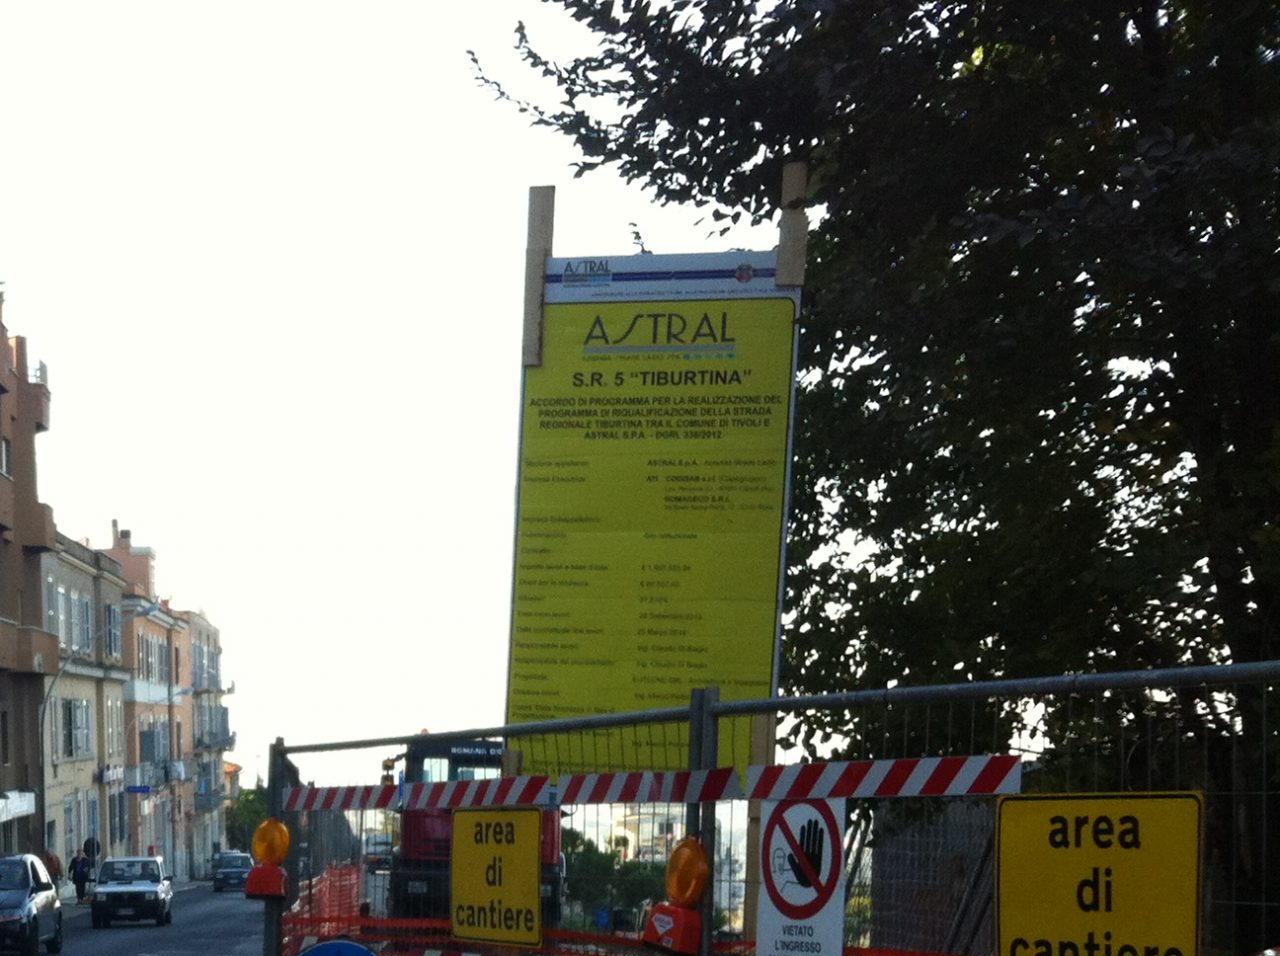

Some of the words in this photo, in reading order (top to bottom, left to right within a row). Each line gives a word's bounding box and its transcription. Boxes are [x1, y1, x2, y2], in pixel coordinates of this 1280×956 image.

[564, 259, 611, 273] ASTRAL
[583, 311, 736, 345] ASTRAL
[572, 372, 607, 388] S.R.
[614, 371, 625, 387] 5
[530, 398, 576, 408] ACCORDO
[578, 397, 587, 407] DI
[589, 396, 650, 406] PROGRAMMA
[652, 396, 672, 405] PER
[674, 395, 685, 405] LA
[687, 394, 762, 405] REALIZZAZIONE
[764, 394, 781, 404] DEL
[538, 409, 598, 418] PROGRAMMA
[600, 408, 610, 417] DI
[612, 407, 697, 417] RIQUALIFICAZIONE
[700, 407, 731, 417] DELLA
[733, 406, 772, 416] STRADA
[540, 420, 592, 430] REGIONALE
[595, 419, 643, 429] TIBURTINA
[646, 419, 664, 429] TRA
[666, 419, 674, 428] IL
[676, 418, 717, 428] COMUNE
[719, 418, 729, 428] DI
[731, 417, 761, 427] TIVOLI
[763, 417, 770, 427] E
[584, 430, 619, 440] ASTRAL
[474, 821, 515, 845] area
[1048, 814, 1141, 849] area
[486, 856, 503, 887] di
[1076, 867, 1113, 912] di
[455, 899, 535, 932] cantiere
[782, 924, 814, 937] VIETATO
[774, 940, 822, 954] L'INGRESSO
